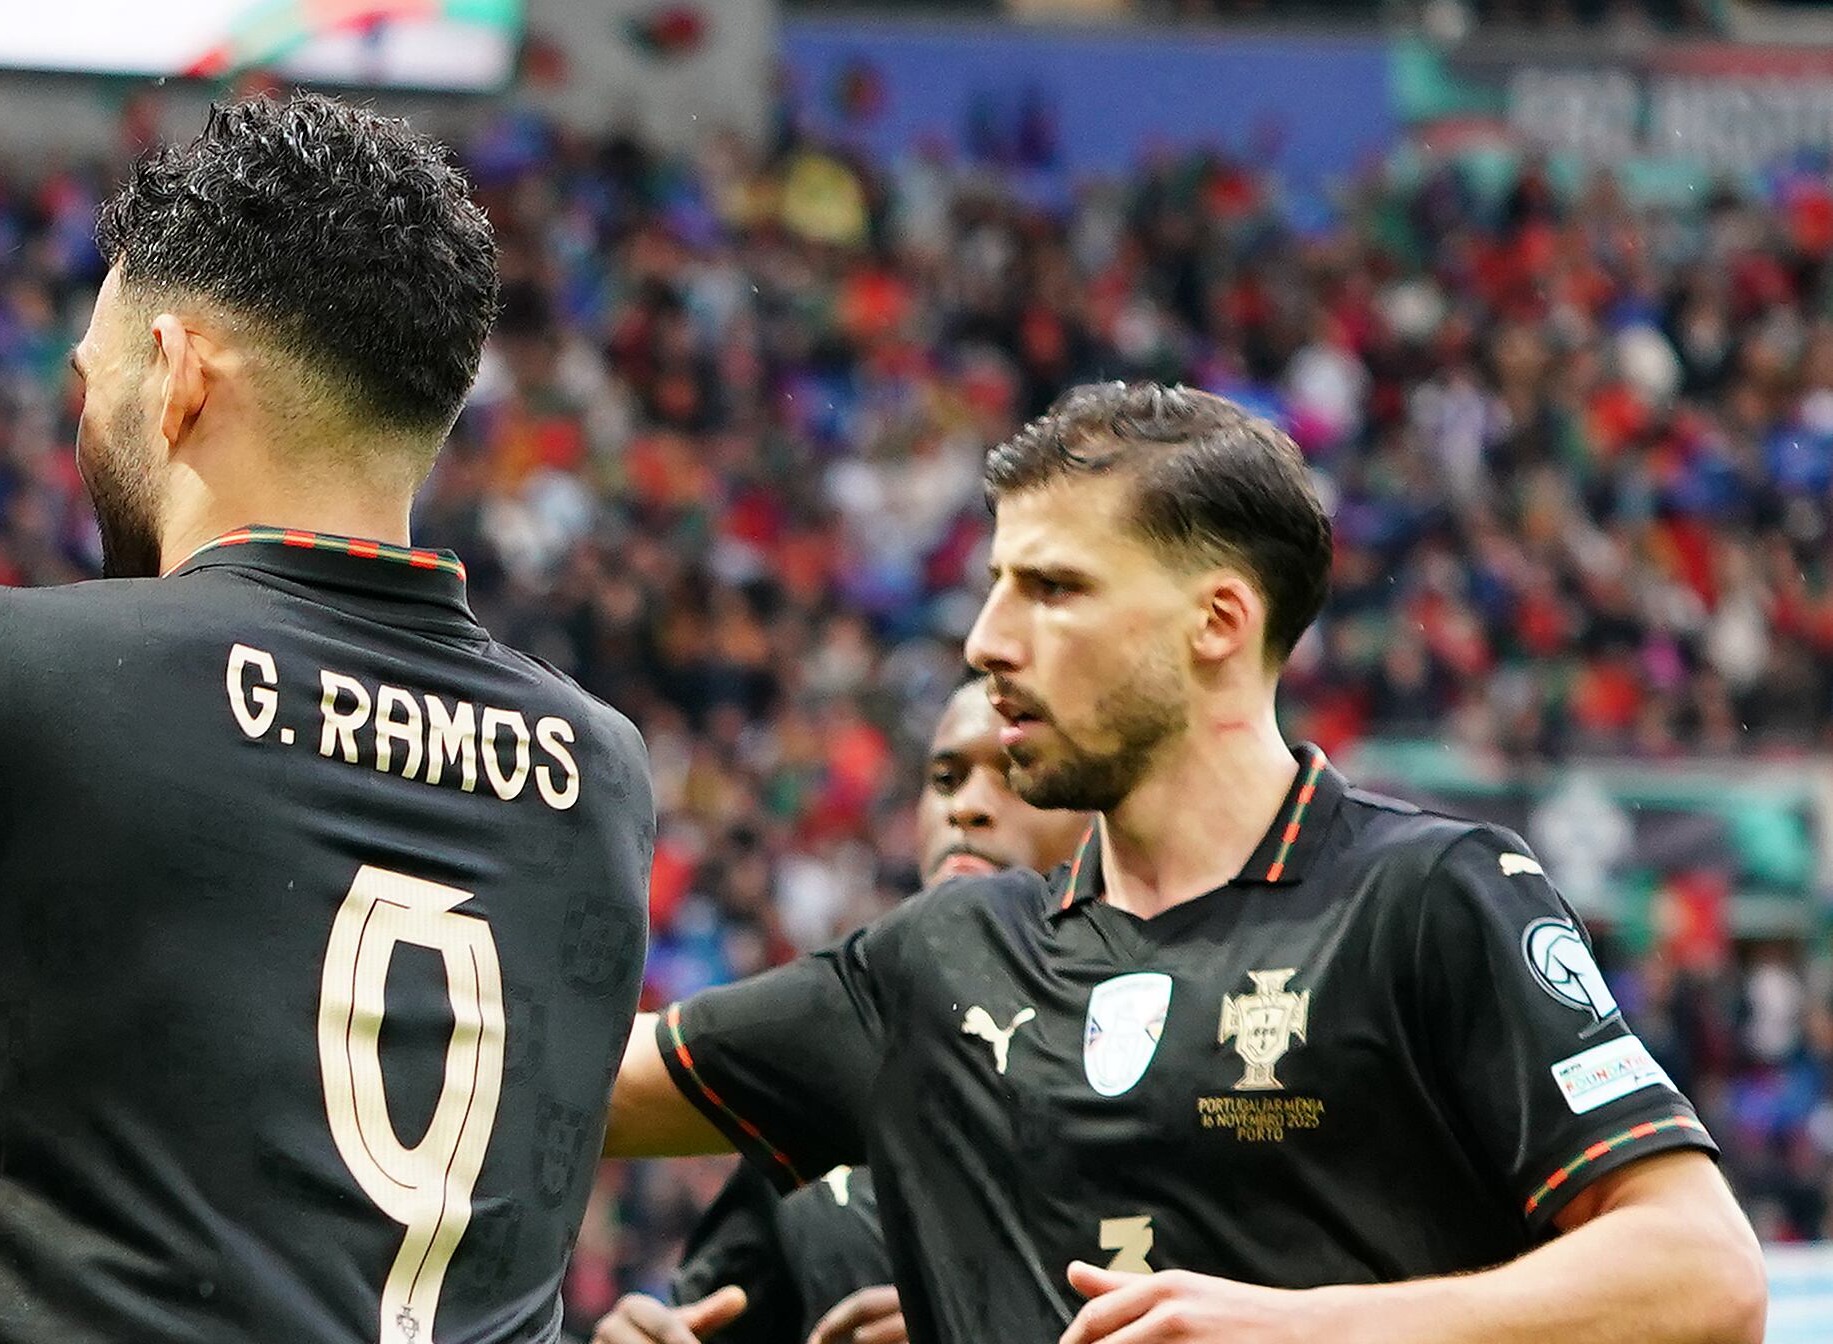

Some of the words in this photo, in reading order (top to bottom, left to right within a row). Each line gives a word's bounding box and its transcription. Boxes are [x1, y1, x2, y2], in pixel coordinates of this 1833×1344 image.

[226, 643, 295, 745] G.
[318, 669, 581, 811] RAMOS
[1236, 1127, 1285, 1142] PORTO
